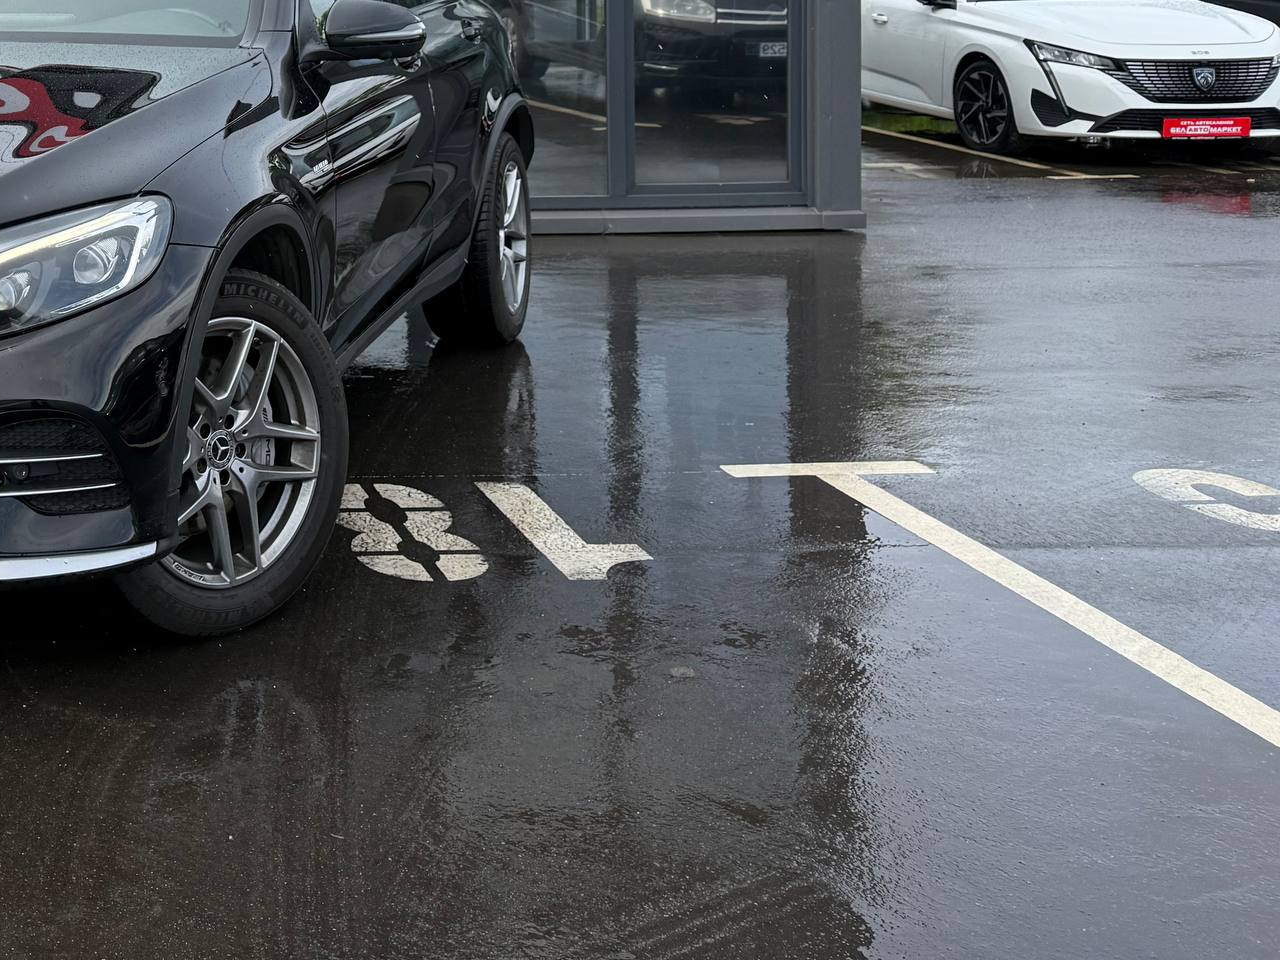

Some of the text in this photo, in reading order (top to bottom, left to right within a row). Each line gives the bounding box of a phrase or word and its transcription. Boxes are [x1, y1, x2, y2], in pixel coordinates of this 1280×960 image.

[1210, 126, 1242, 134] МАРКЕТ
[223, 282, 308, 326] MICHELIN
[337, 481, 654, 583] 18
